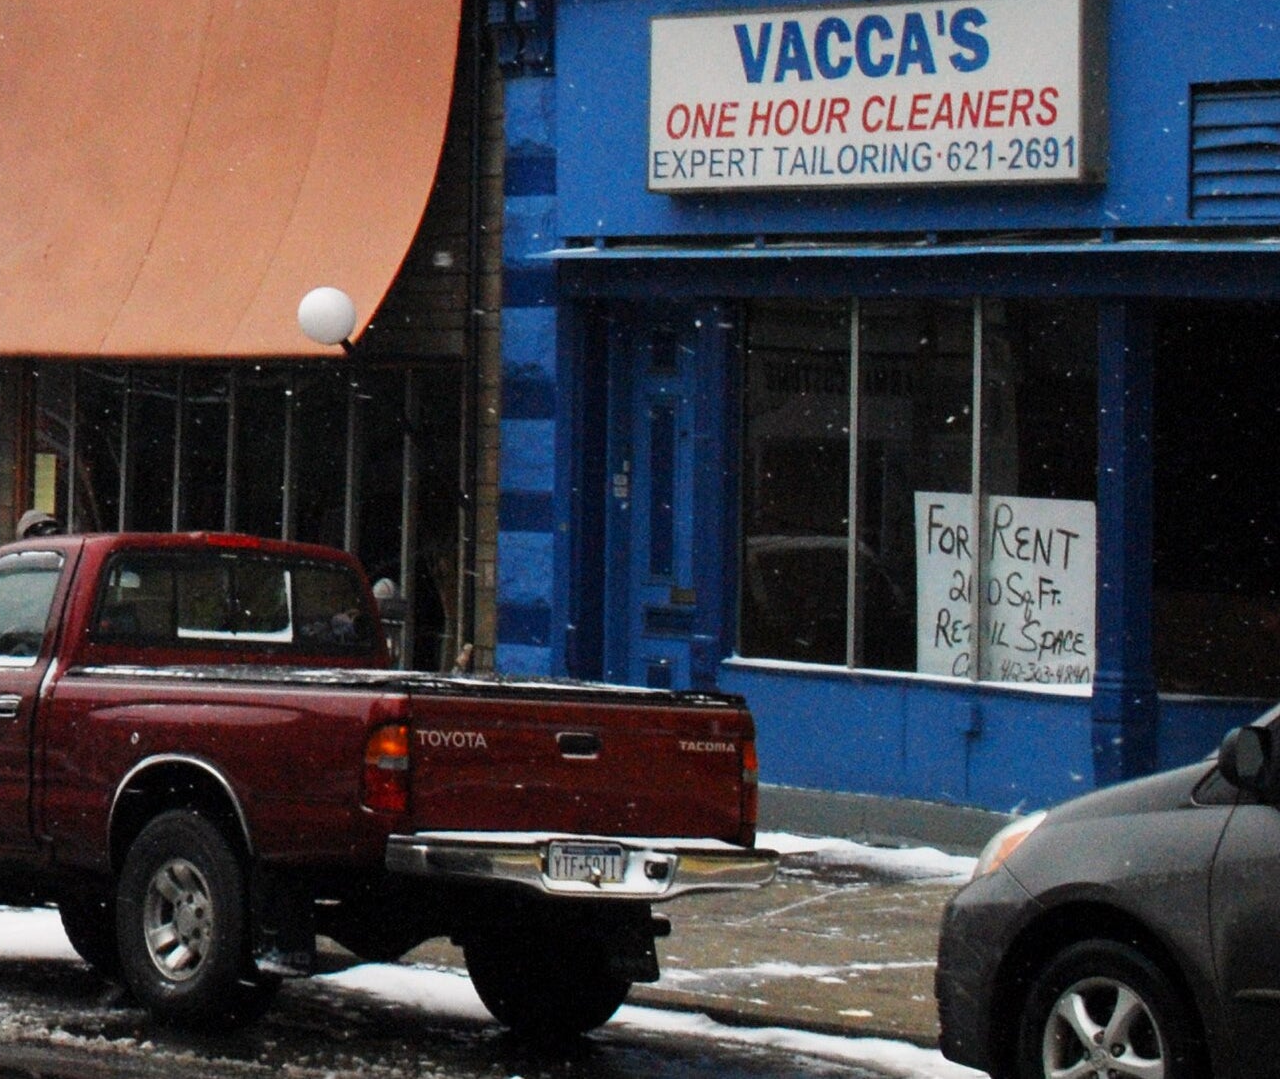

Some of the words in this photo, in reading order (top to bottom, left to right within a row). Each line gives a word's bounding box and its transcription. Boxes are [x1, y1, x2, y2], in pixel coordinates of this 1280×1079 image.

[733, 6, 990, 85] VACCA'S
[666, 102, 740, 140] ONE
[748, 97, 852, 137] HOUR
[861, 86, 1060, 134] CLEANERS
[653, 146, 764, 180] EXPERT
[946, 135, 1078, 172] 621-2691
[927, 504, 973, 560] FOR
[990, 503, 1080, 571] RENT
[1015, 620, 1087, 662] SPACE
[416, 729, 488, 749] TOYOTA
[679, 740, 737, 753] TACOMA
